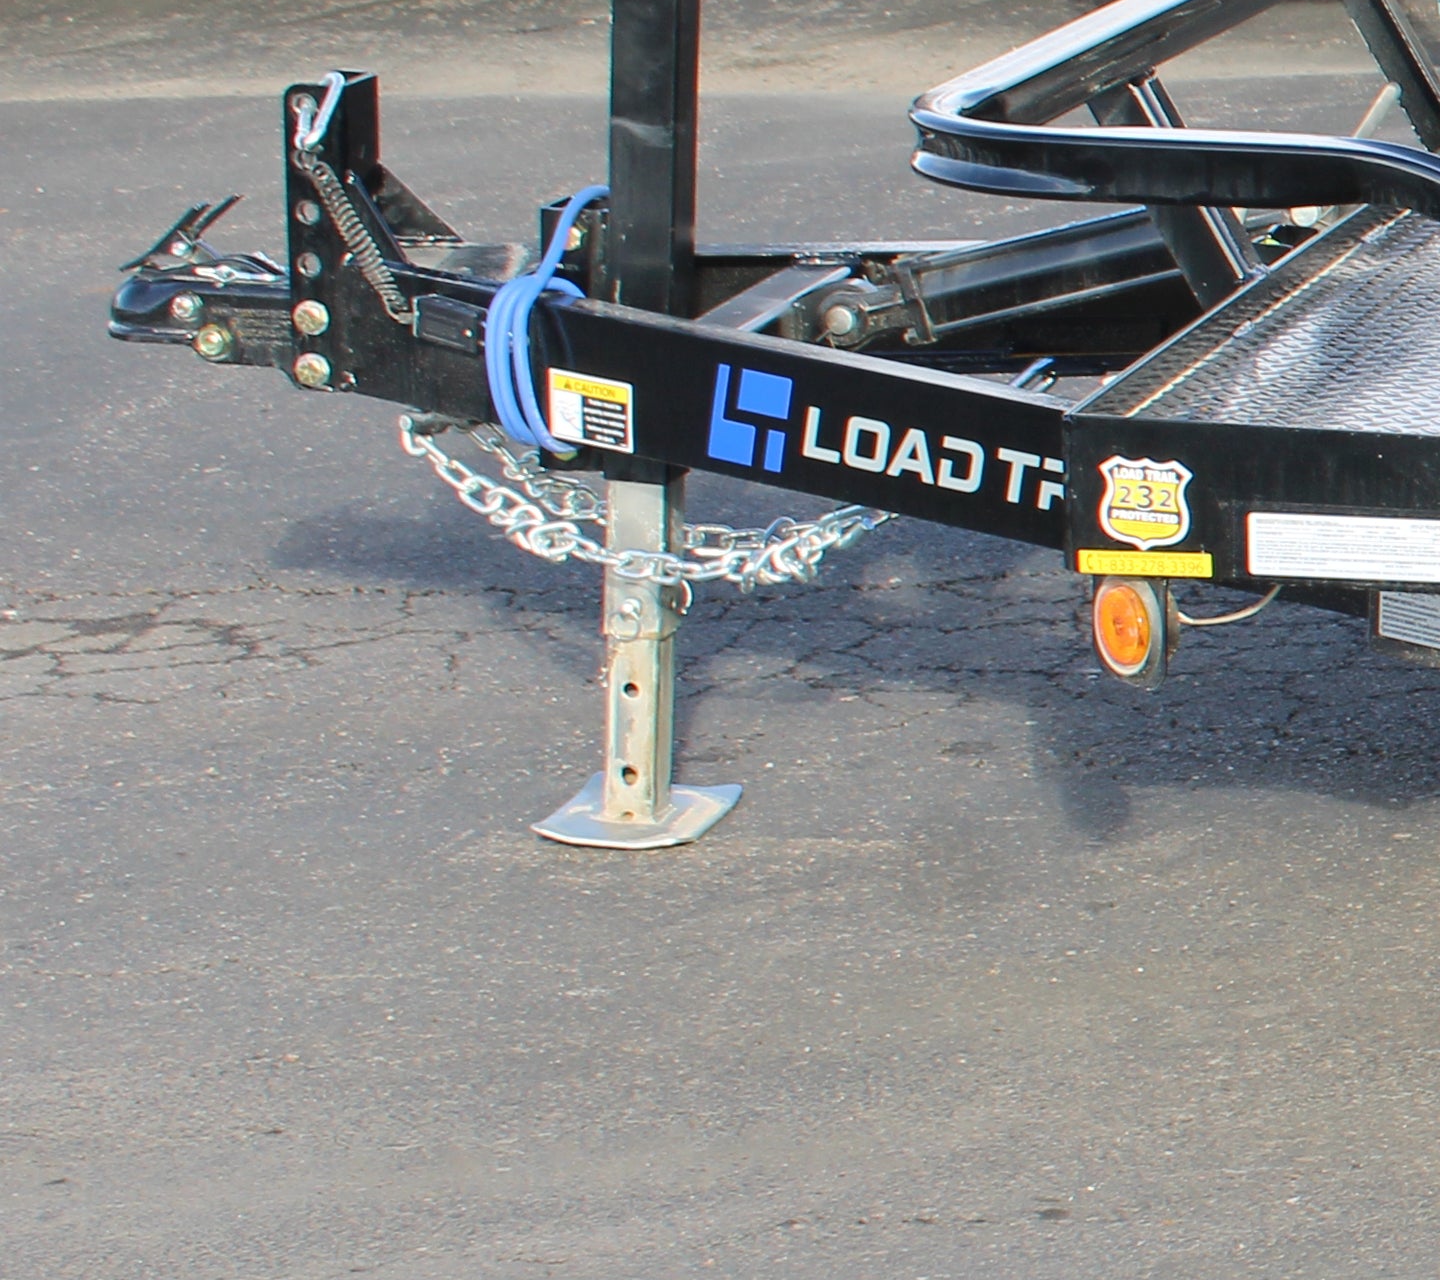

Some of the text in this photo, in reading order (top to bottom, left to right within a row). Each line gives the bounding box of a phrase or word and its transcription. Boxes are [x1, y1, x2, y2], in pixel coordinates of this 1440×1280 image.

[574, 381, 616, 398] CAUTION
[801, 406, 985, 494] LOAD
[1114, 467, 1180, 483] LOAD TRAIL
[1111, 509, 1179, 524] PROTECTED
[1098, 559, 1204, 574] 1-833-278-3396
